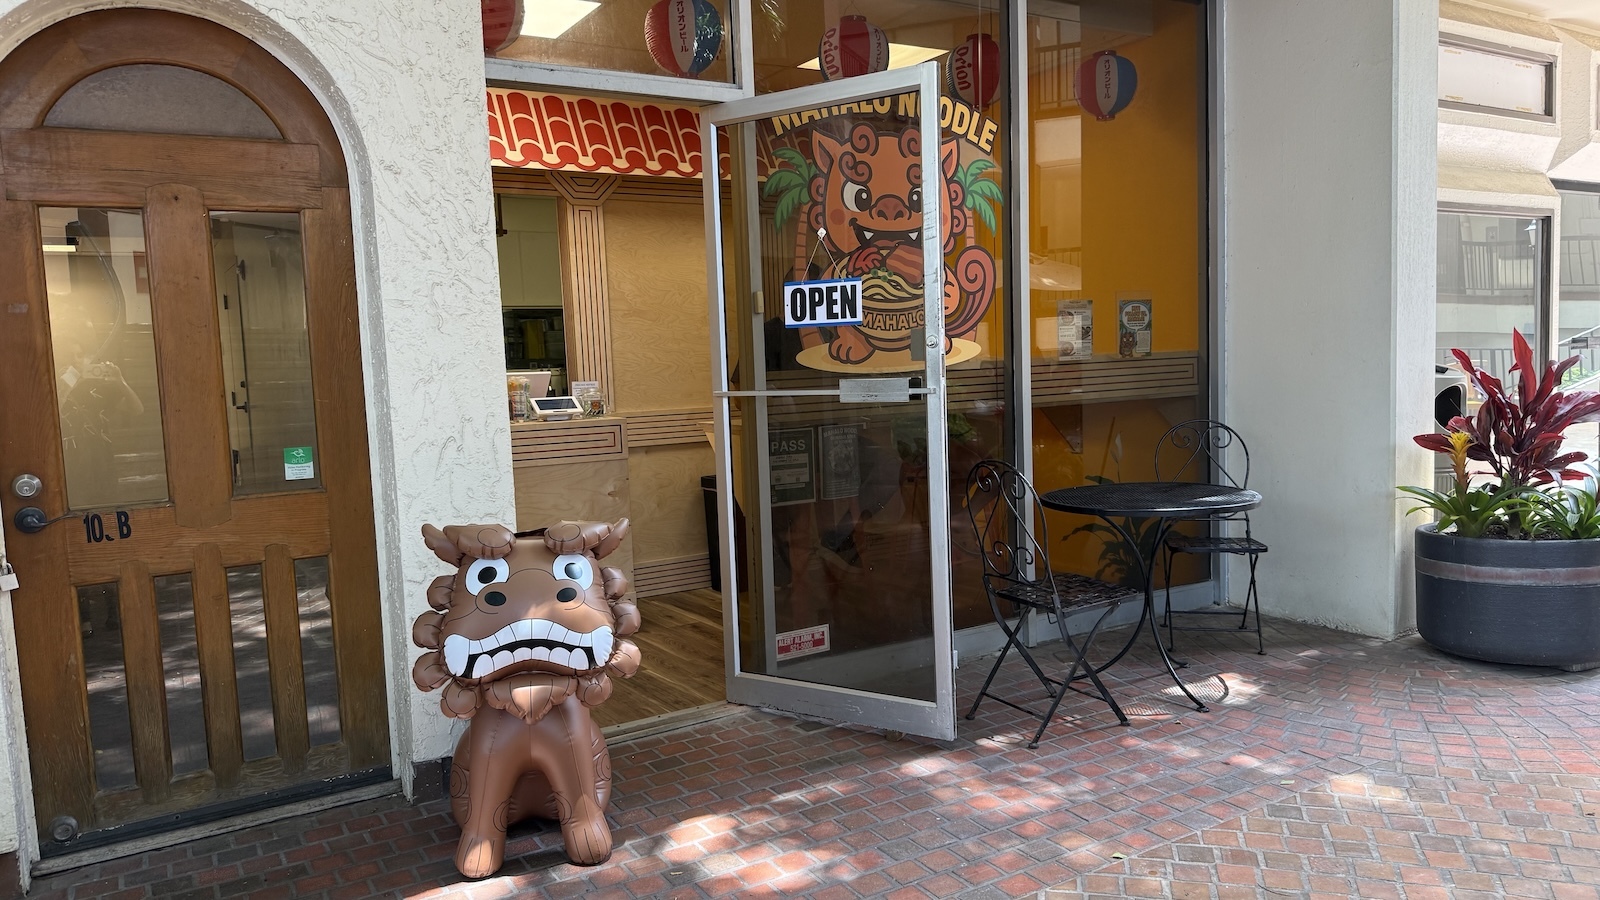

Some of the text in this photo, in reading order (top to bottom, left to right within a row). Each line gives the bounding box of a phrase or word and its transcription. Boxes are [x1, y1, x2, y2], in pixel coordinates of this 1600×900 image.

[676, 1, 689, 53] オリオンビール
[898, 91, 998, 153] NODLE
[790, 284, 858, 322] OPEN
[862, 309, 925, 331] MAHALO
[771, 440, 806, 452] PASS
[778, 637, 794, 647] ALERT
